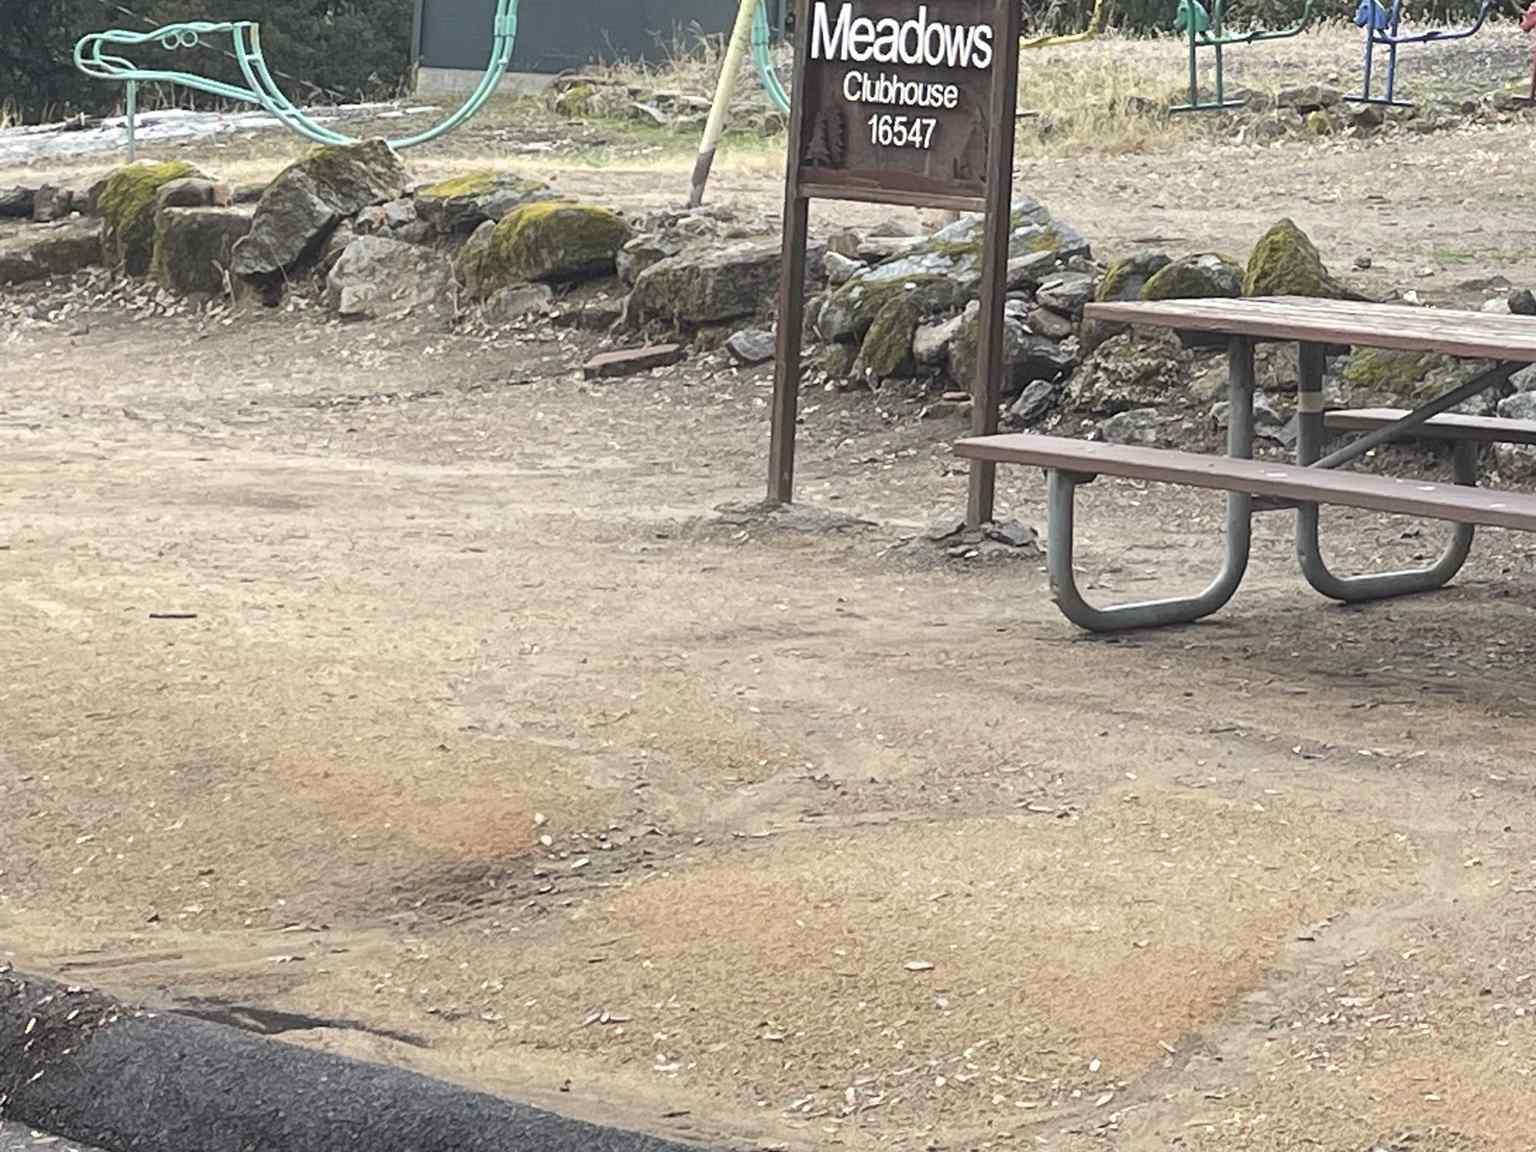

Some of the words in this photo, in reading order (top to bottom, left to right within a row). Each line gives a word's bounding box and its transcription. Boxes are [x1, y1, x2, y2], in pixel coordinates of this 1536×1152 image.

[811, 2, 993, 68] Meadows
[842, 70, 959, 108] Clubhouse
[868, 114, 937, 148] 16547
